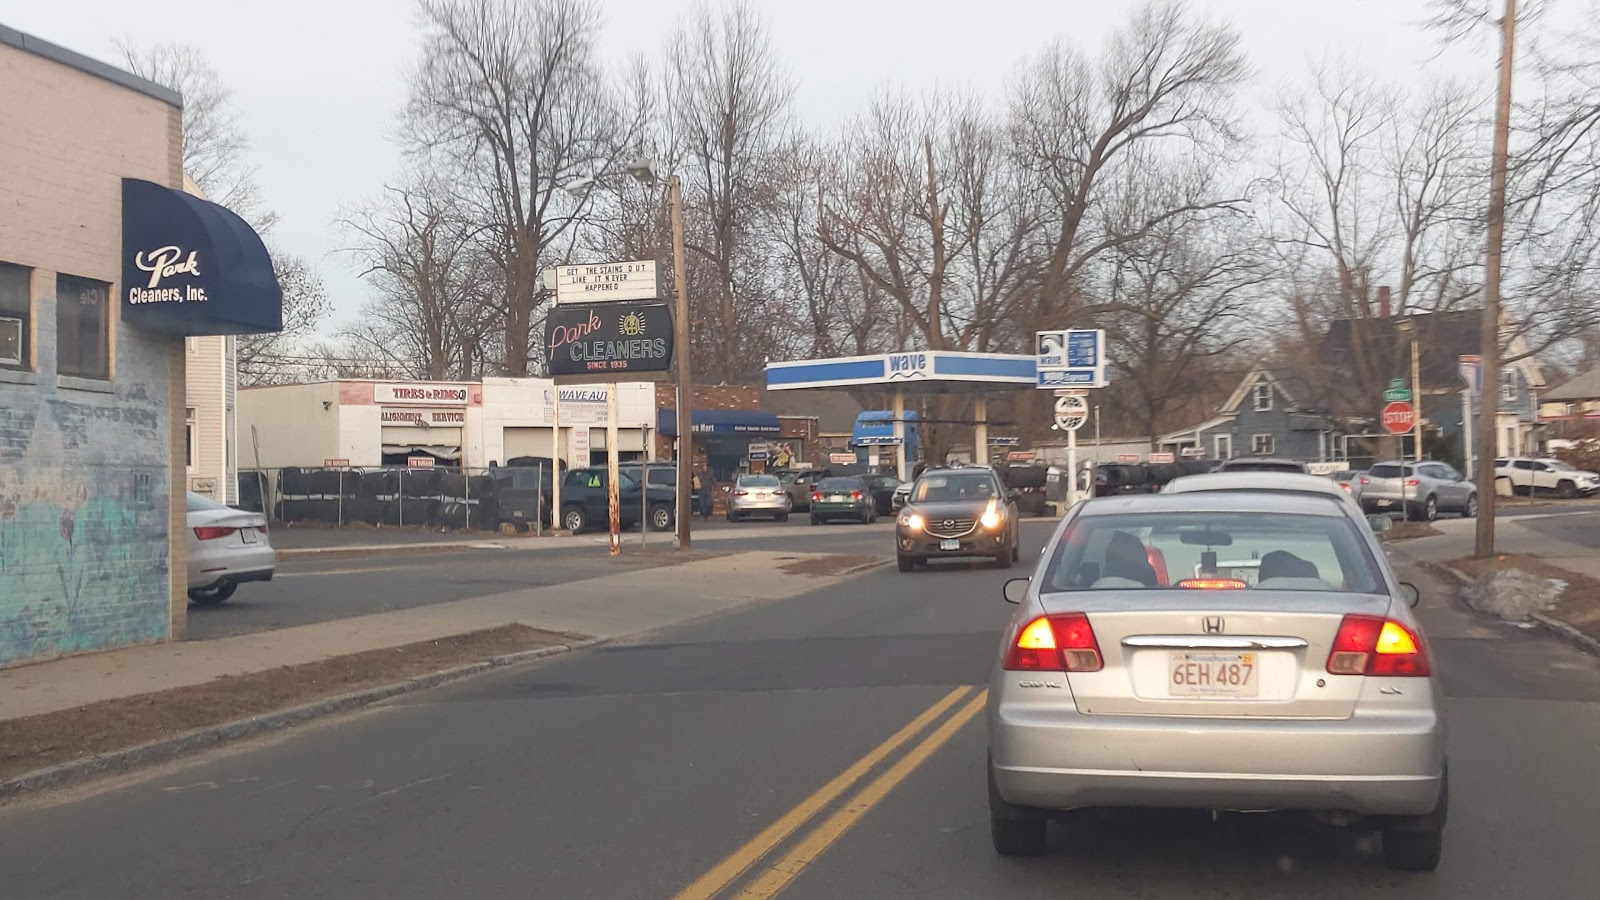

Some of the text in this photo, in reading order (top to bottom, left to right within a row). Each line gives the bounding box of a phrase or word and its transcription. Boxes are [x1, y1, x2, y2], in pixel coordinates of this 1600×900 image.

[135, 245, 200, 289] Park
[567, 268, 578, 276] GET
[586, 267, 597, 275] THE
[600, 265, 623, 275] STAINS
[572, 274, 628, 284] LIKE IT NEVER
[585, 283, 619, 291] HAPPENED
[129, 284, 208, 305] Cleaners, Inc.
[547, 309, 602, 361] Park
[569, 337, 666, 361] CLEANERS
[586, 360, 627, 369] SINCE 1935
[889, 353, 926, 372] wave
[392, 388, 425, 399] TIRES
[433, 390, 458, 401] RIMS
[559, 389, 608, 401] WAVE AUT
[432, 412, 464, 422] SERVICE
[1383, 411, 1414, 424] STOP
[1173, 663, 1254, 686] 6EH 487
